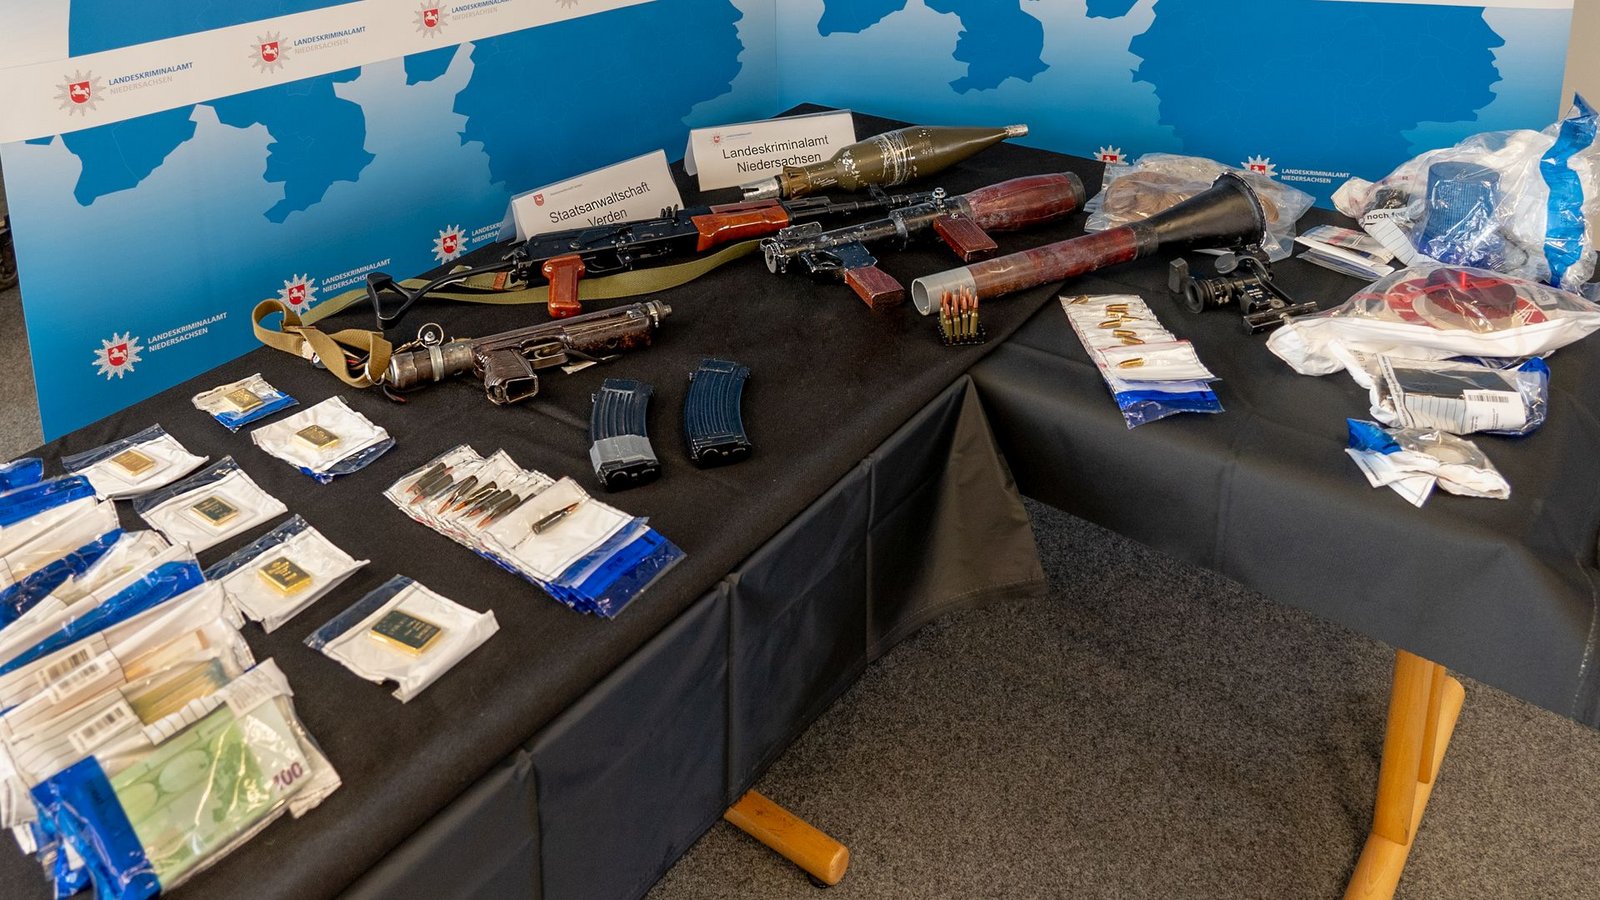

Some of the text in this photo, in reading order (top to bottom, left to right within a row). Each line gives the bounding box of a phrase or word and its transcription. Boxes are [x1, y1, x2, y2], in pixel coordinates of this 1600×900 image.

[293, 26, 366, 47] LANDESKRIMINALAMT
[294, 39, 349, 55] NIEDERSACHSEN
[108, 62, 193, 86] LANDESKRIMINALAMT
[109, 76, 173, 95] NIEDERSACHSEN
[722, 135, 830, 160] Landeskriminalamt
[737, 153, 822, 174] Niedersachsen
[1281, 168, 1351, 179] LANDESKRIMINALAMT
[1280, 175, 1332, 184] NIEDERSACHSEN
[549, 181, 651, 224] Staatsanwaltschaft
[587, 208, 628, 227] Verden
[472, 230, 501, 244] NIEDERSA
[322, 258, 391, 286] LANDESKRIMINALAMT
[147, 311, 228, 345] LANDESKRIMINALAMT
[148, 327, 209, 353] NIEDERSACHSEN
